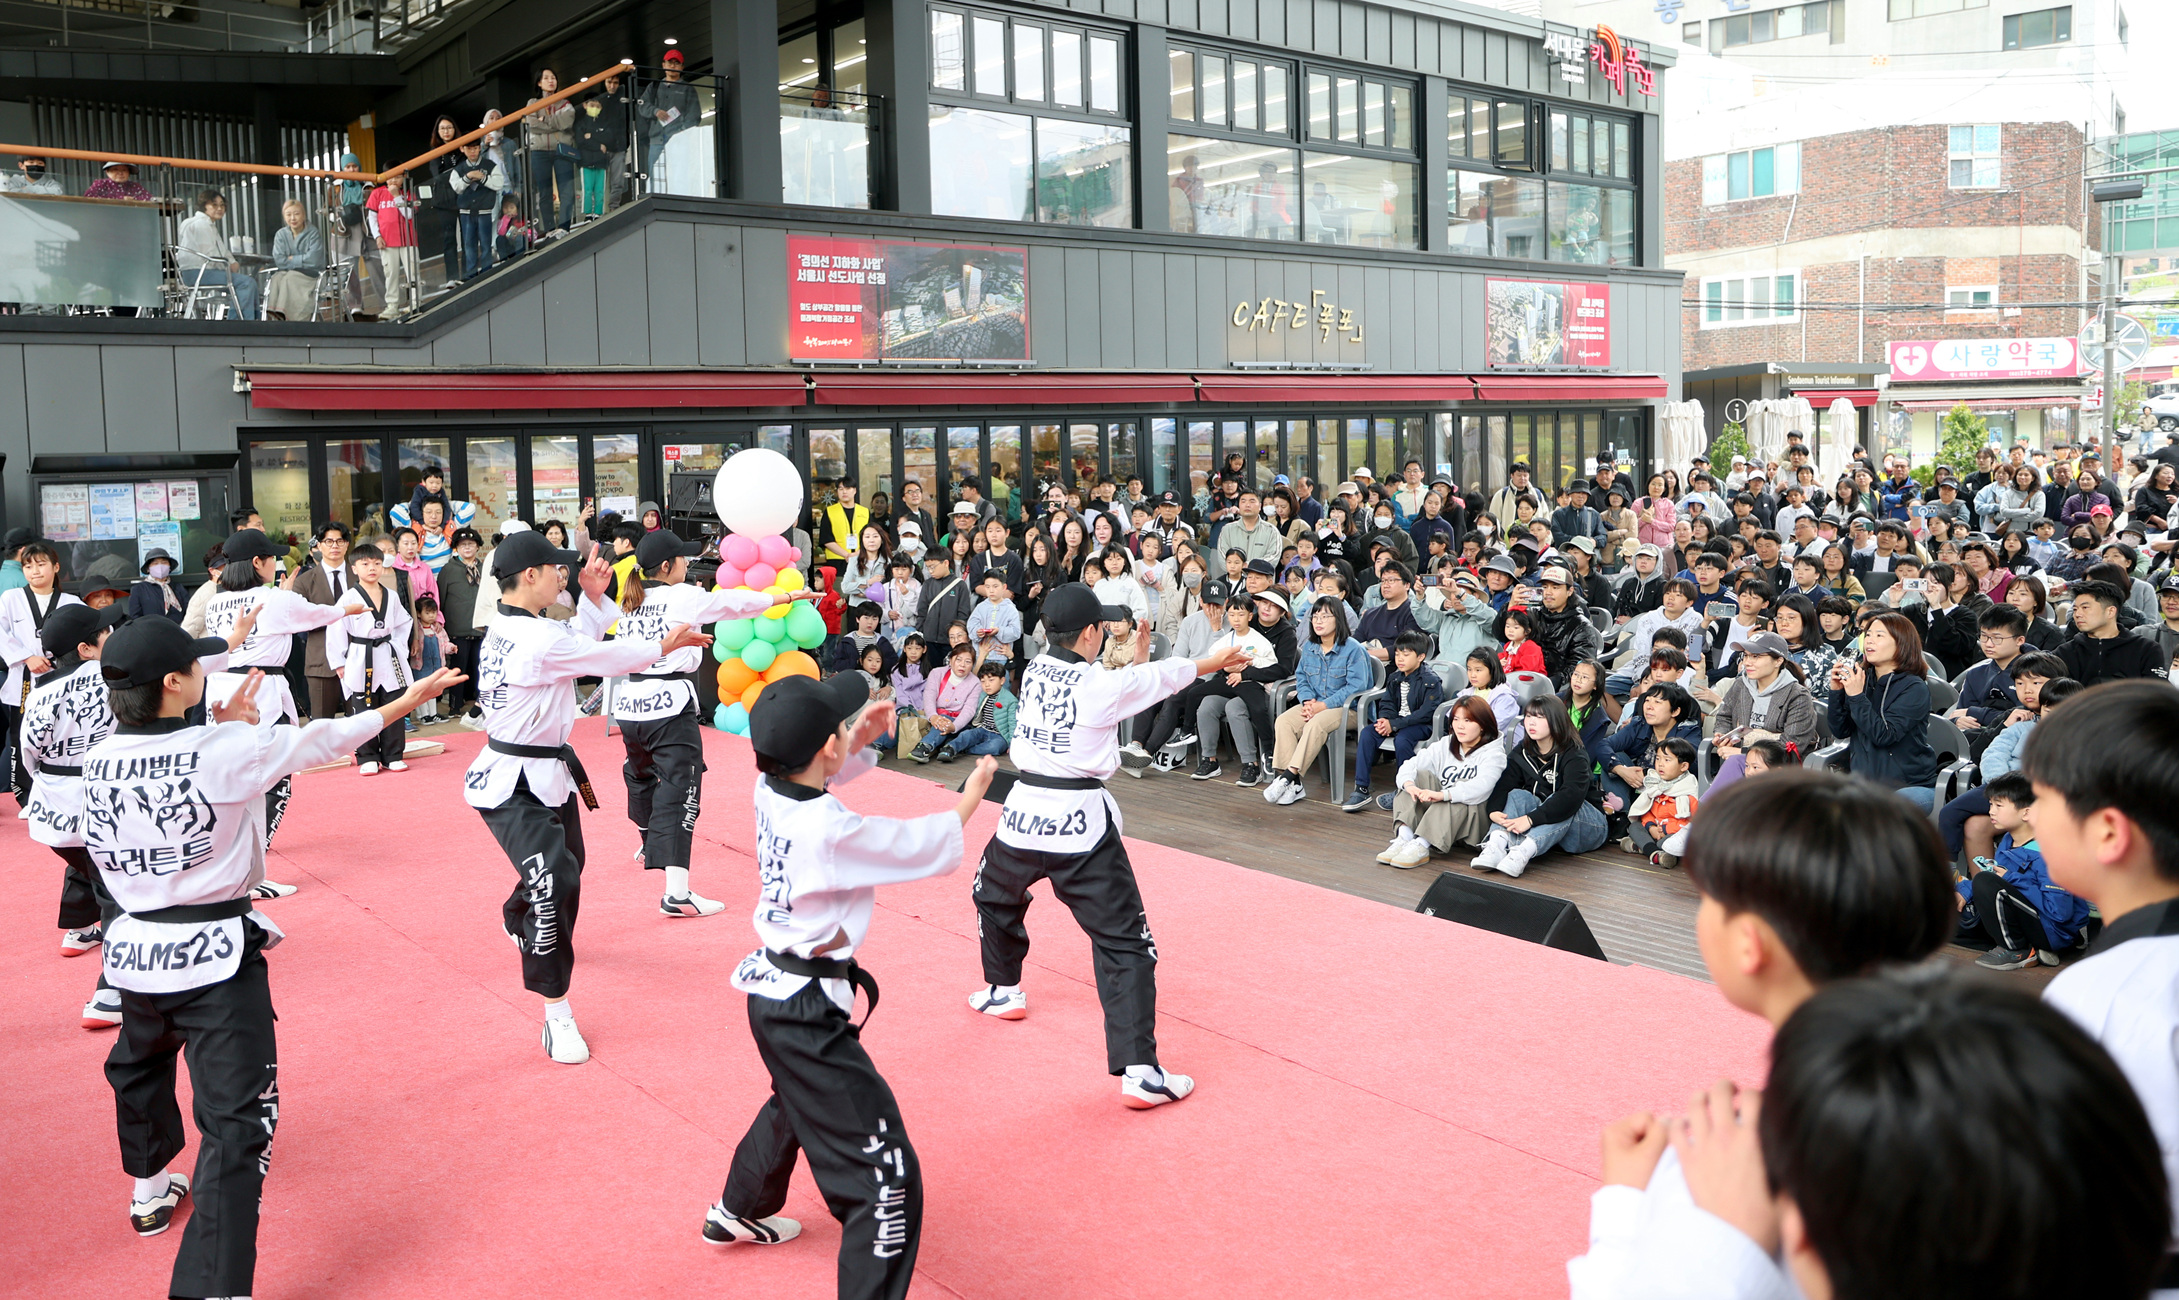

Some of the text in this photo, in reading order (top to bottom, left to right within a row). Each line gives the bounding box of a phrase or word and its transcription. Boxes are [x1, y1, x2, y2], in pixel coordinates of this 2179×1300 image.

[1543, 32, 1586, 62] 서대문
[832, 255, 861, 269] 지하화
[797, 269, 886, 285] 서울시 선도사업 선정
[1233, 297, 1307, 333] CAFE
[1950, 341, 2057, 367] 사랑약국
[95, 836, 214, 876] 고려튼튼
